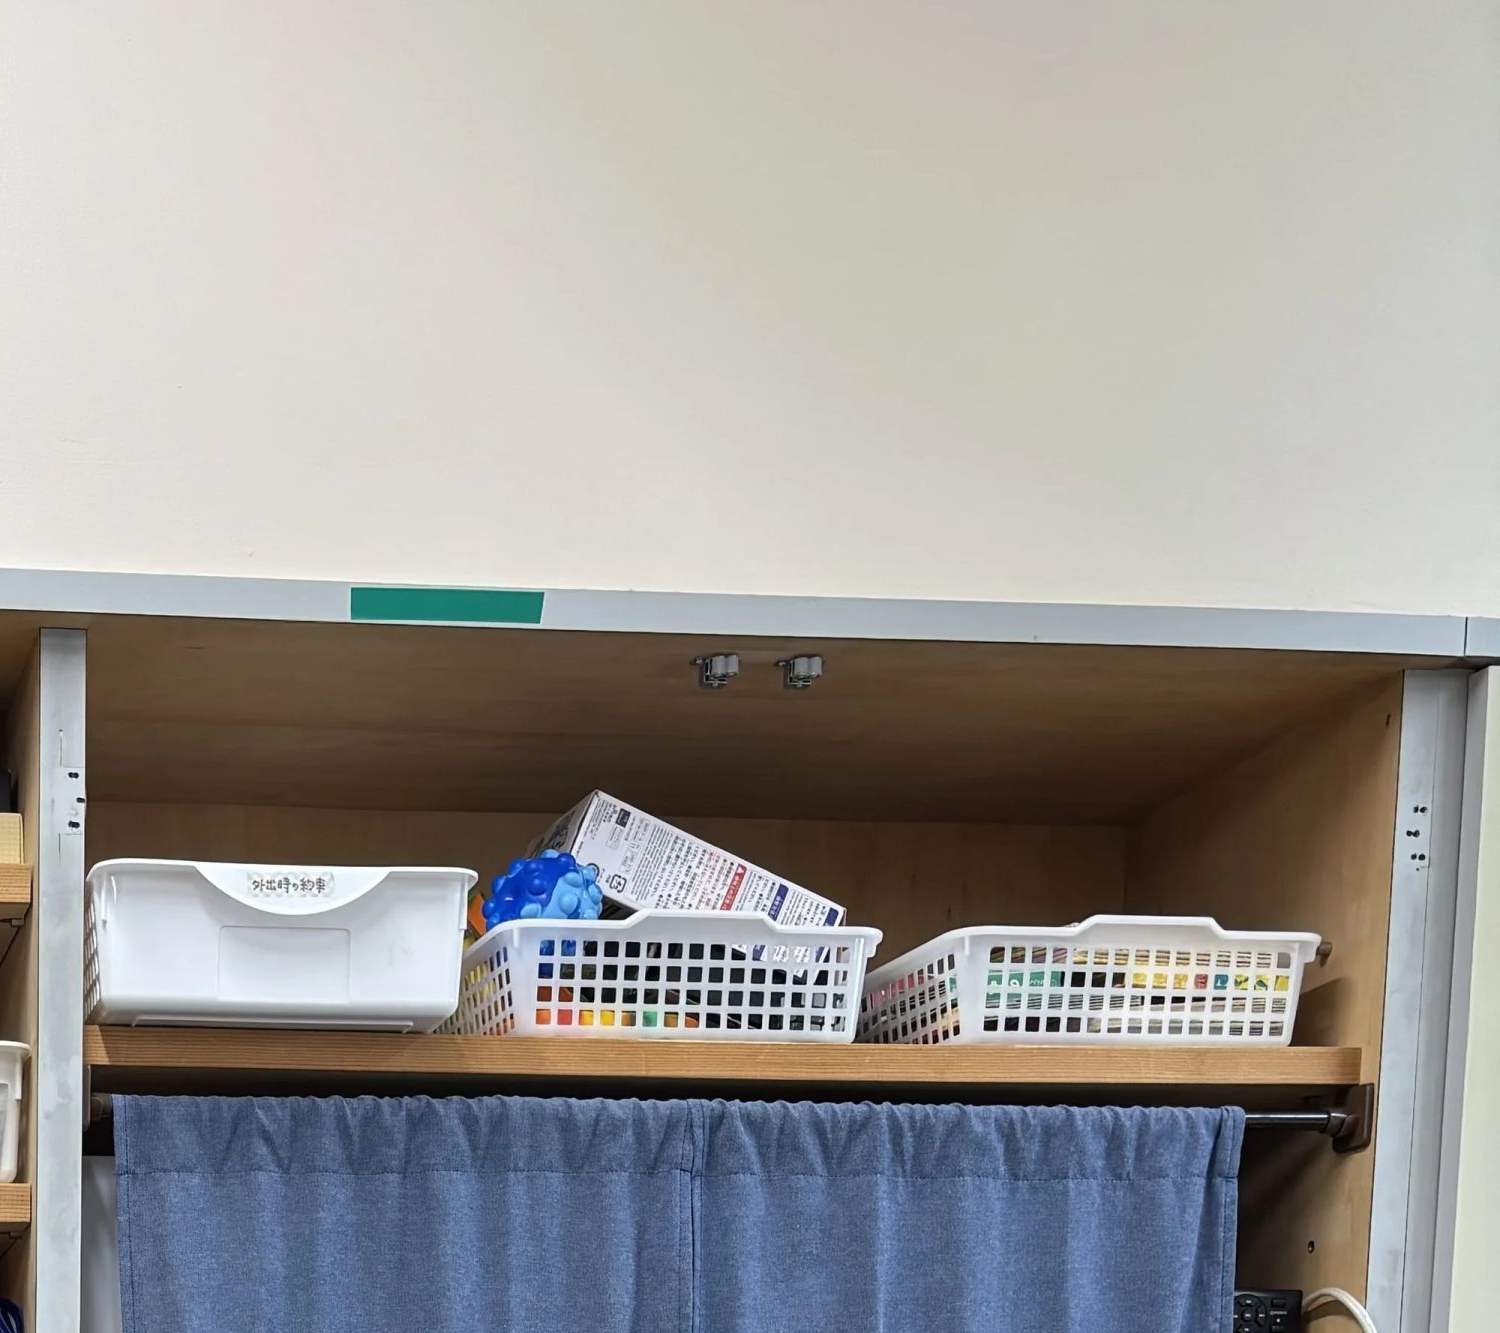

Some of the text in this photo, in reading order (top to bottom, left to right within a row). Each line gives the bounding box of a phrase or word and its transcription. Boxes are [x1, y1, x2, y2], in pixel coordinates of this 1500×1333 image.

[251, 876, 326, 894] 外出時の約束
